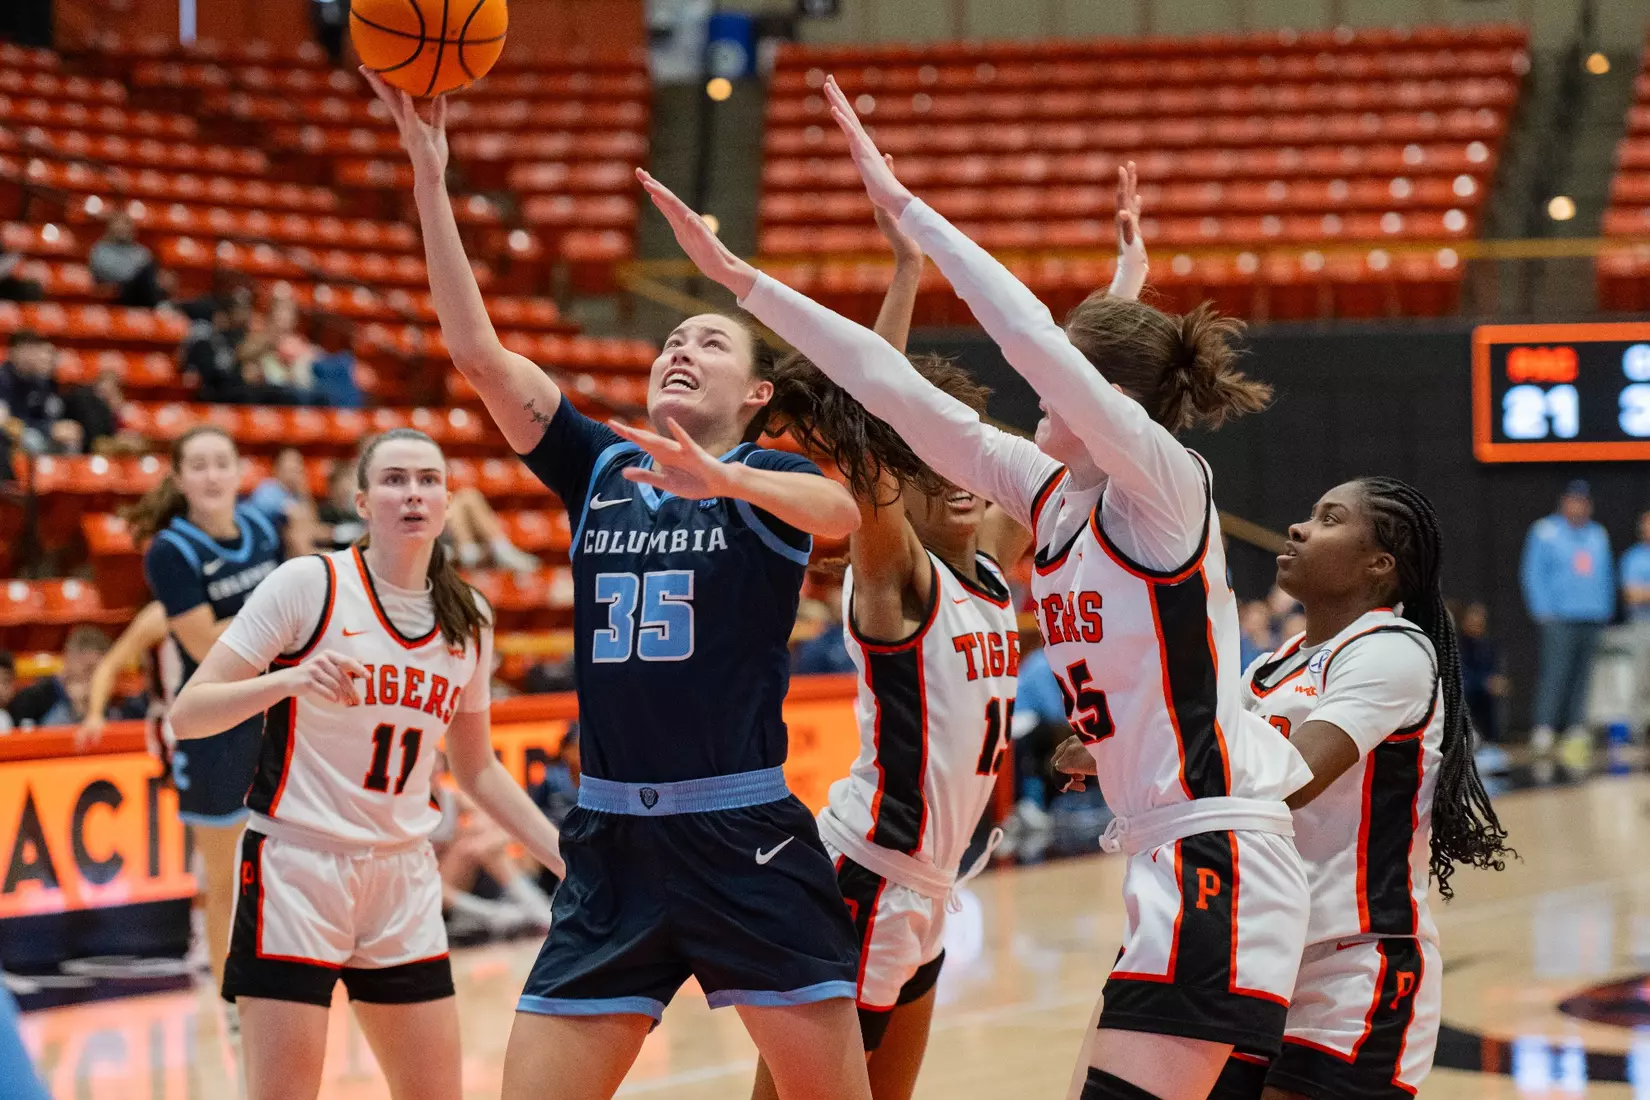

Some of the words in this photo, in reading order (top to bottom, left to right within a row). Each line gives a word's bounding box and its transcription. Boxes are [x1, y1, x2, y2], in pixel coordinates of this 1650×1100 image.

[1502, 384, 1579, 439] 21
[583, 526, 728, 556] COLUMBIA
[592, 570, 695, 663] 35
[363, 722, 424, 796] 11
[1196, 867, 1221, 910] P
[1389, 970, 1415, 1010] P
